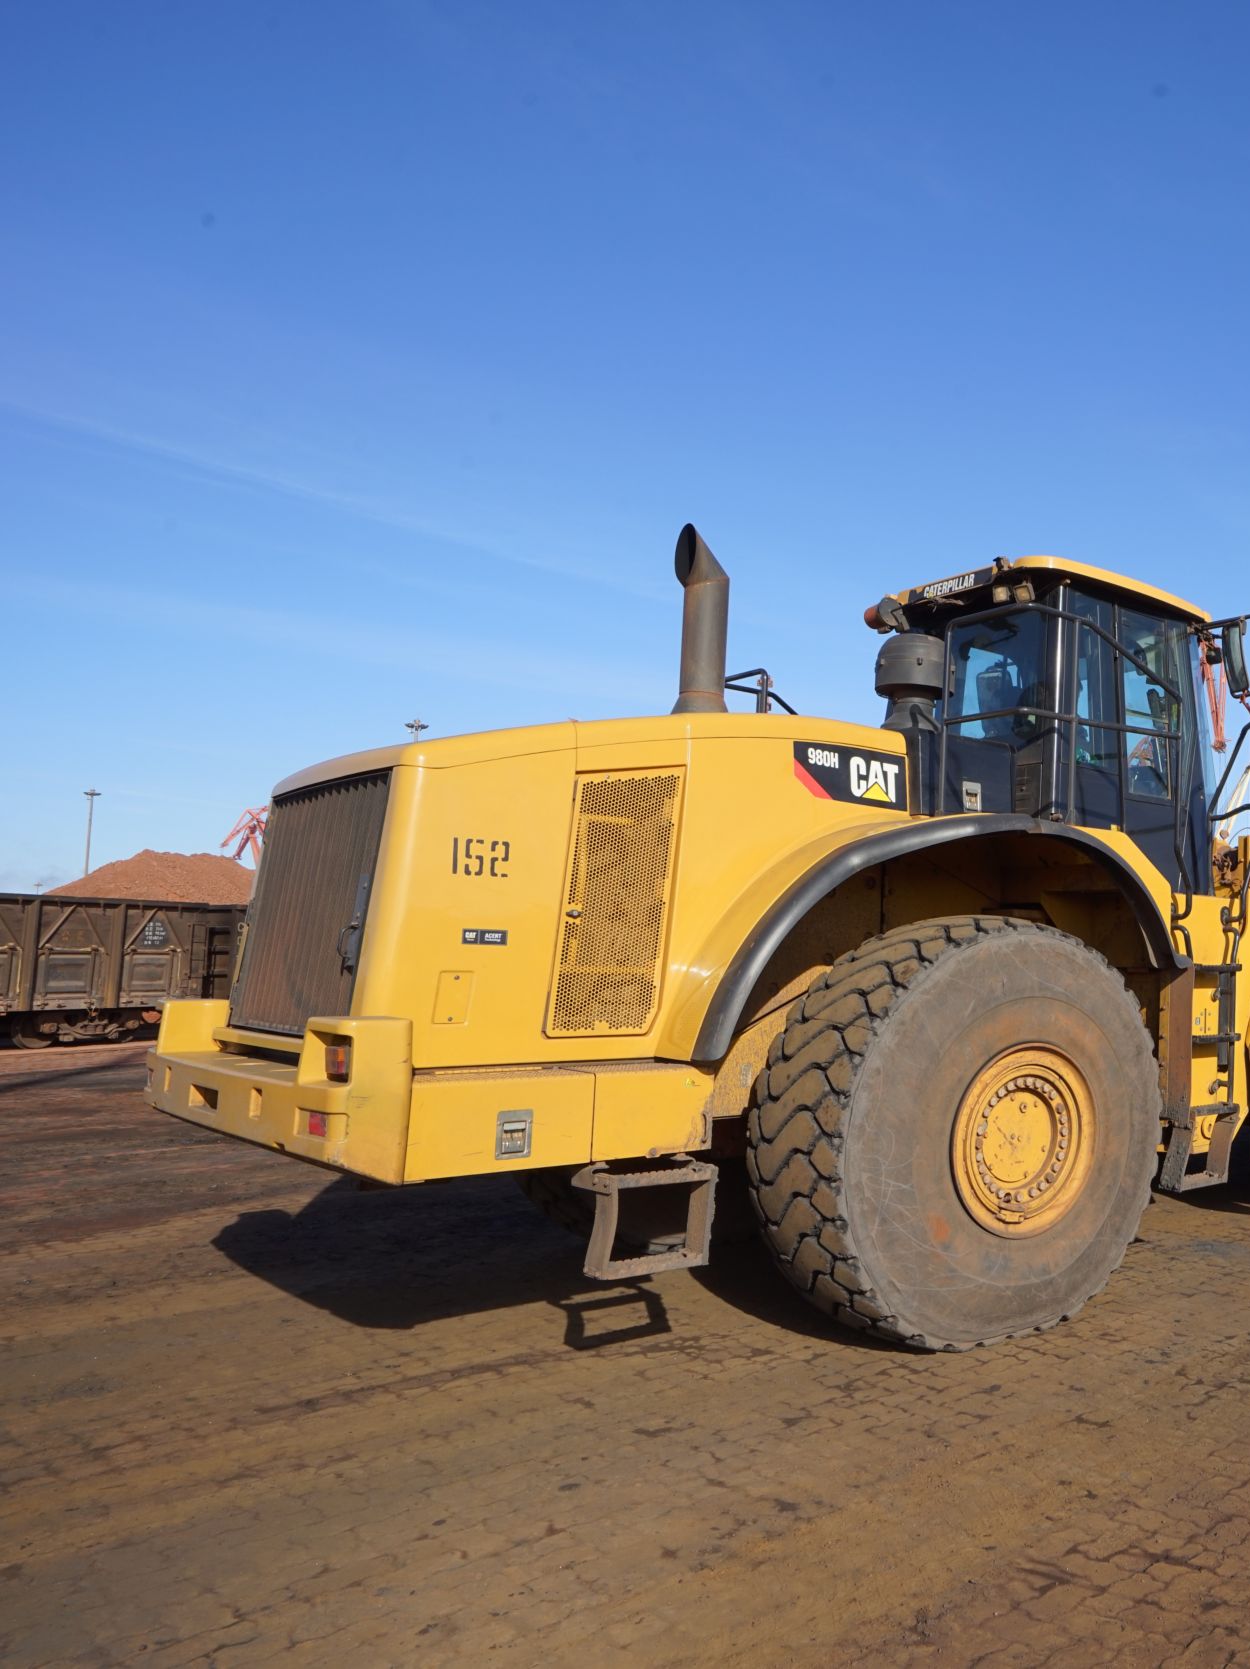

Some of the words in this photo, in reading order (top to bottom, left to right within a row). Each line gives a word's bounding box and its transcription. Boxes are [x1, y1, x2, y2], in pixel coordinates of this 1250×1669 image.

[923, 574, 975, 599] CATERPILLAR
[807, 747, 839, 769] 980H
[849, 756, 899, 803] CAT
[452, 837, 510, 878] 152
